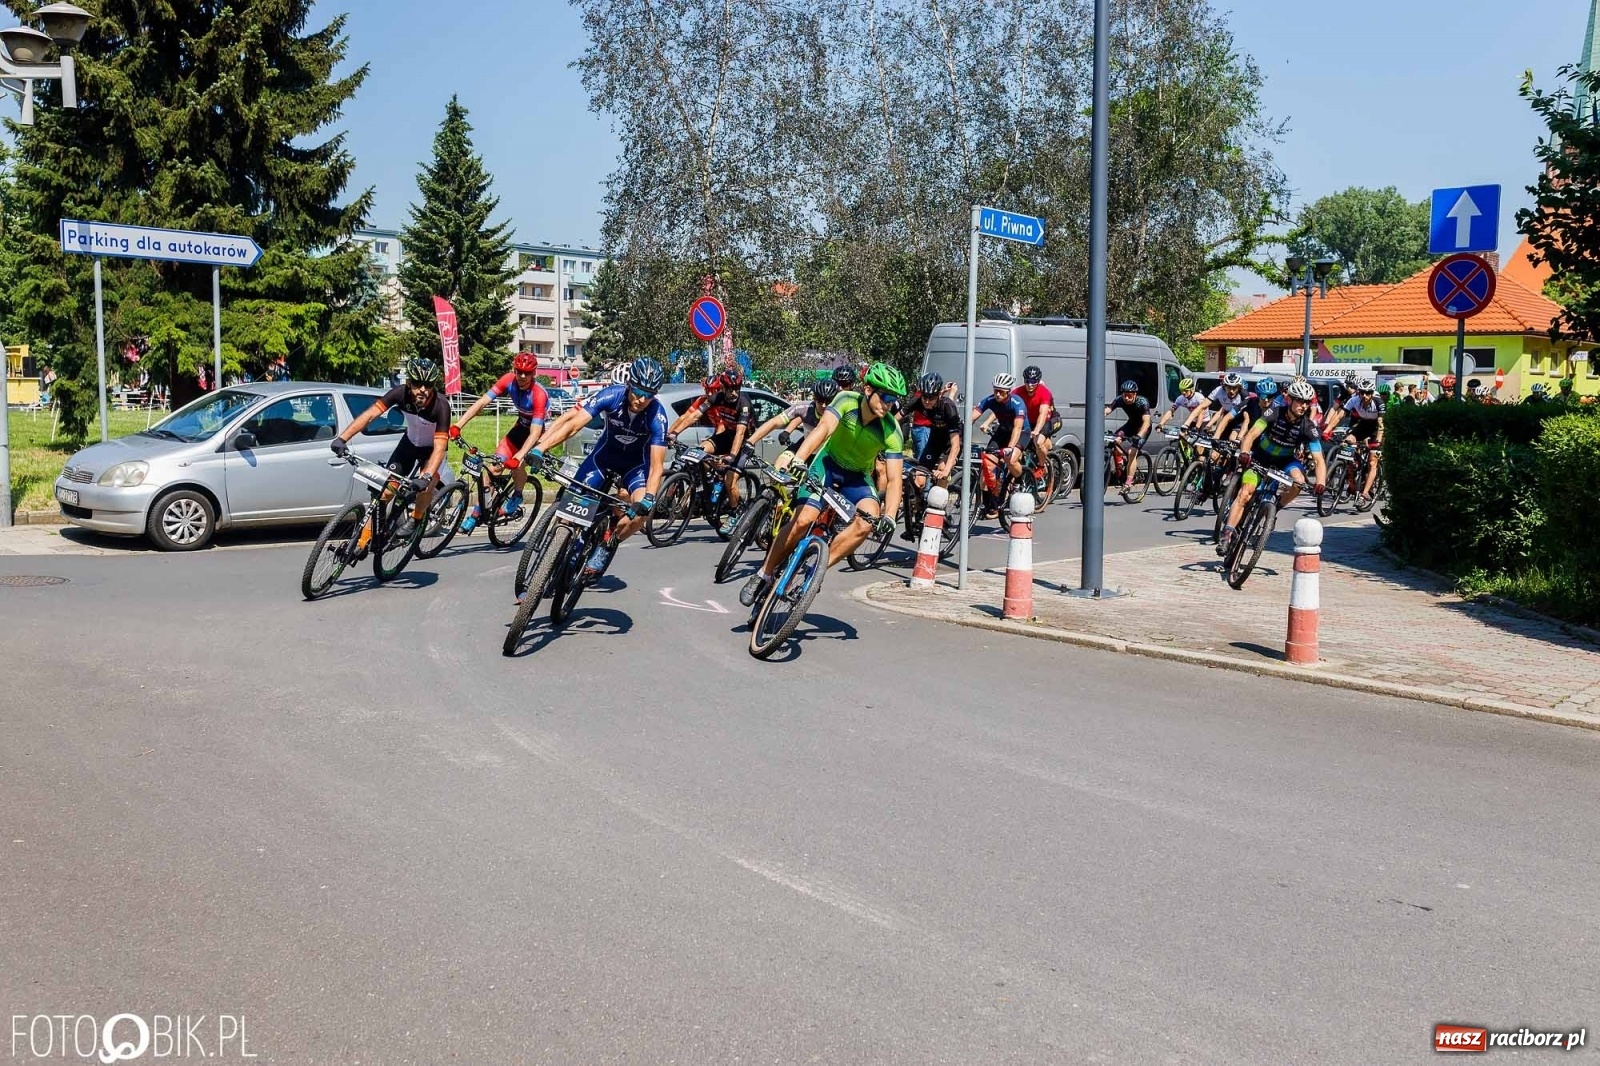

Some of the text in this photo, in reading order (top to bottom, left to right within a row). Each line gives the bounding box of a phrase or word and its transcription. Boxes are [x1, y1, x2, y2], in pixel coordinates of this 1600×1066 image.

[984, 213, 1033, 237] ul. Piwna
[68, 229, 247, 258] Parking dla autokarów
[1332, 344, 1365, 354] SKUP
[1309, 369, 1324, 377] 690
[1325, 369, 1340, 377] 856
[565, 502, 589, 517] 2120
